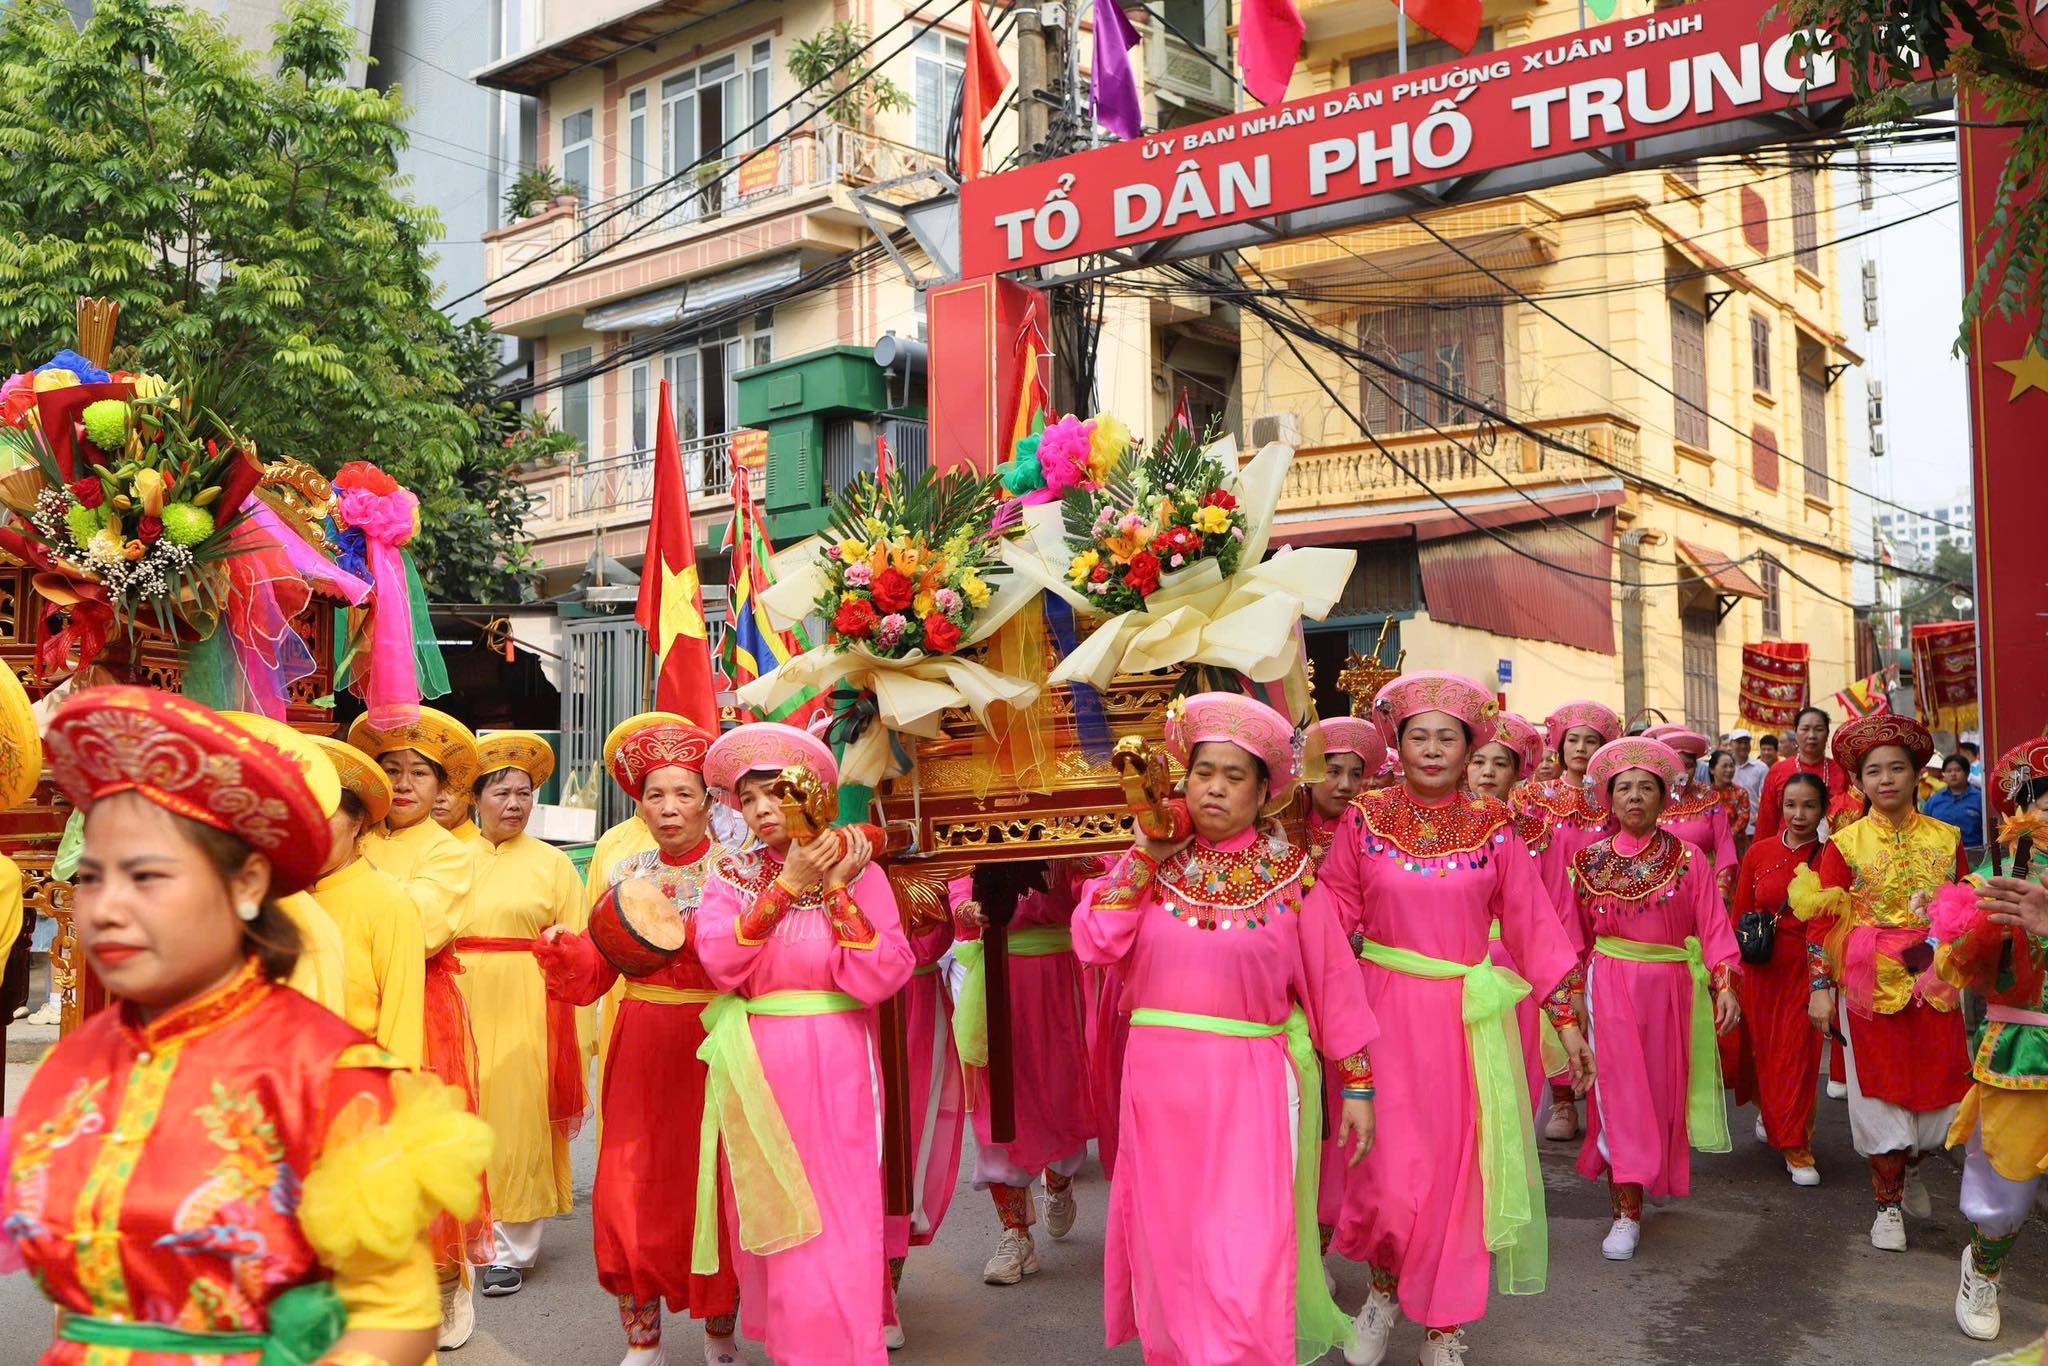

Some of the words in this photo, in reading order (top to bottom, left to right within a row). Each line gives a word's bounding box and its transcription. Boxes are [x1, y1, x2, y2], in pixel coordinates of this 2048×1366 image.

[994, 172, 1081, 260] TỔ
[1113, 153, 1273, 238] DÂN
[1308, 85, 1480, 197] PHỐ
[1511, 28, 1837, 149] TRUNG
[1141, 138, 1176, 160] ỦY
[1183, 124, 1236, 151] BAN
[1241, 106, 1316, 138] NHÂN
[1323, 89, 1384, 118] DÂN
[1392, 60, 1512, 102] PHƯỜNG
[1522, 35, 1613, 73] XUÂN
[1623, 13, 1704, 48] ĐỈNH
